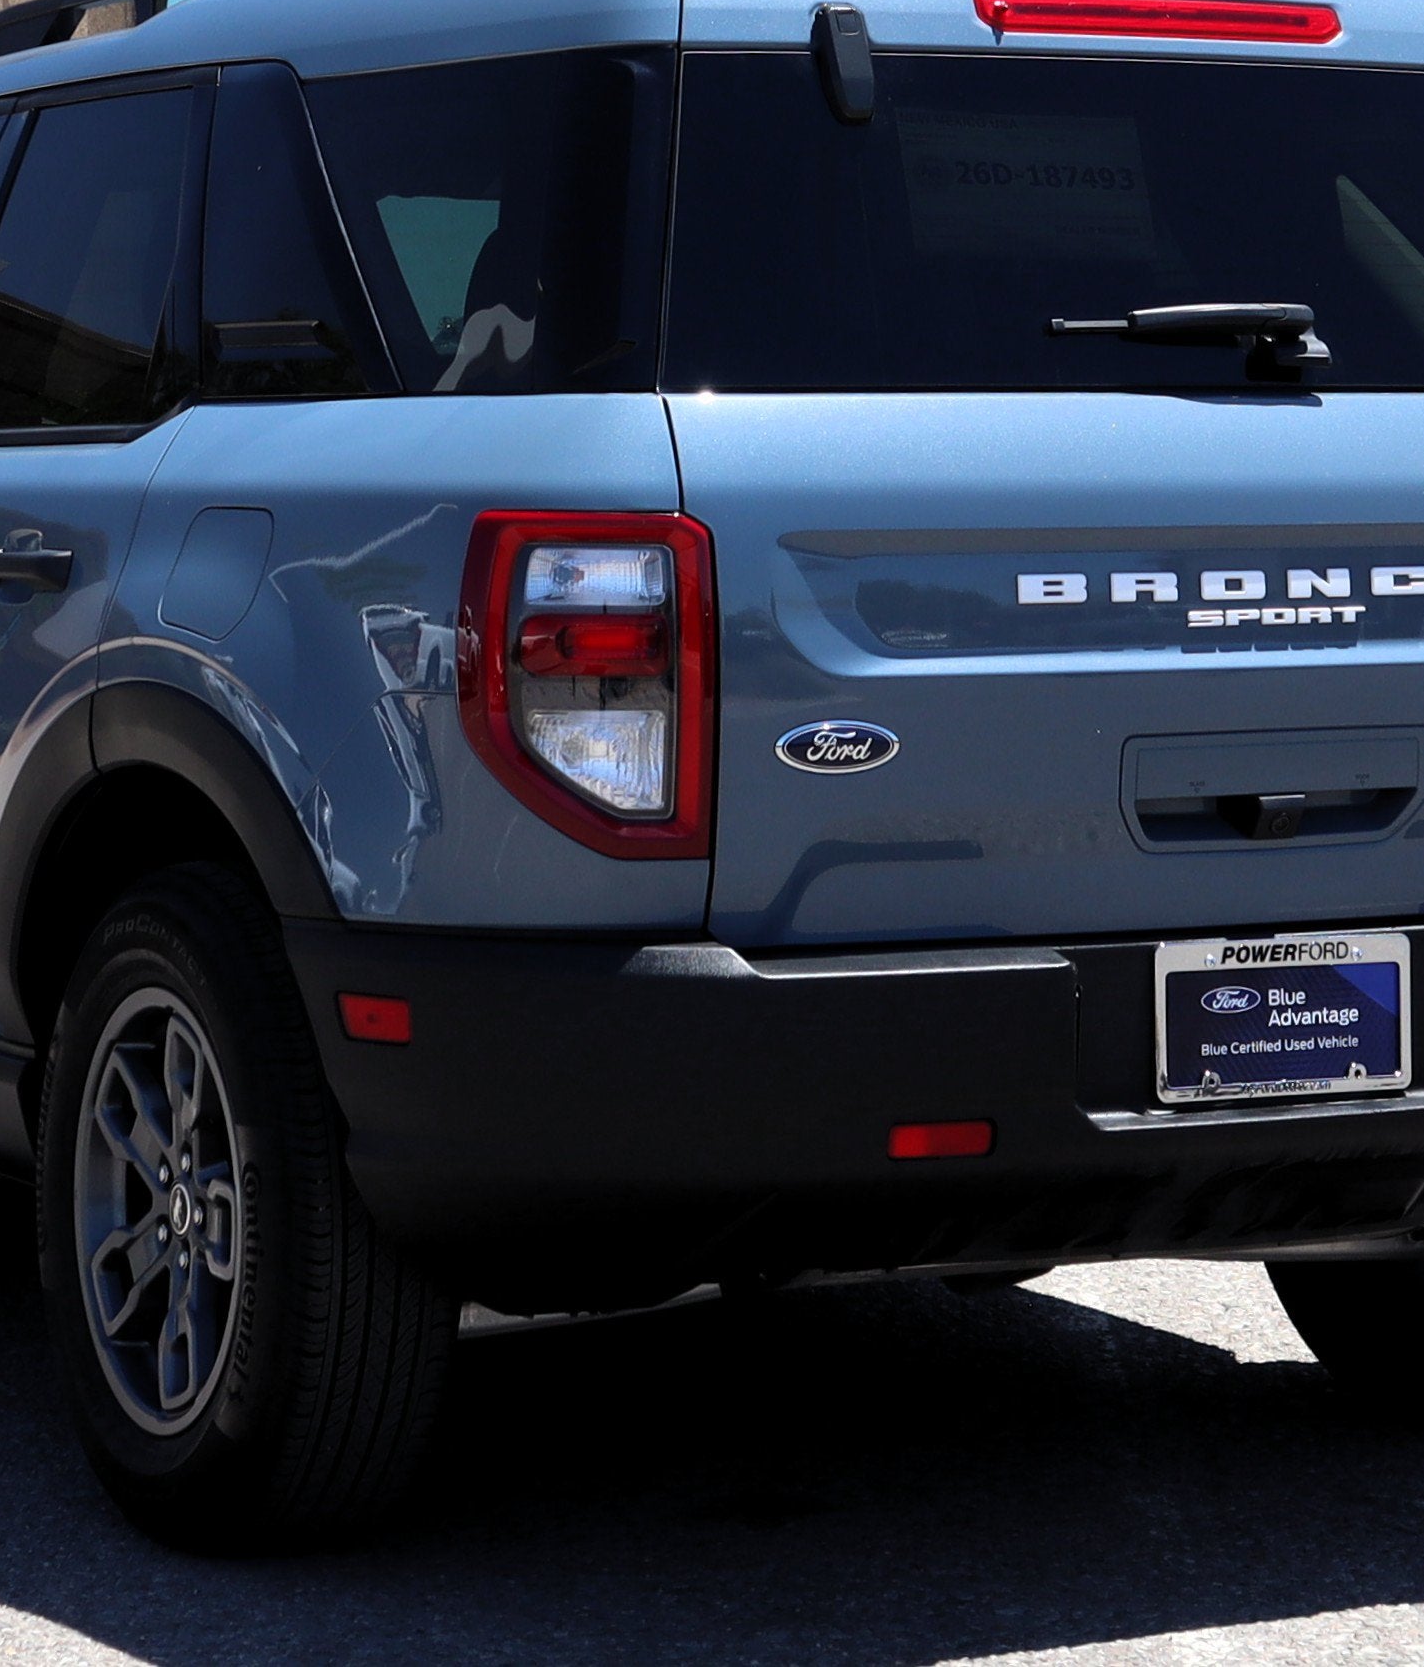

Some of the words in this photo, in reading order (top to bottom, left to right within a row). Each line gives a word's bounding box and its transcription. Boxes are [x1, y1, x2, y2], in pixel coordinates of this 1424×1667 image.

[955, 160, 1135, 191] 26D-187493
[1186, 604, 1366, 629] SPORT
[806, 730, 873, 761] Ford
[1221, 941, 1349, 964] POWERFORD
[1212, 990, 1249, 1010] Ford
[1268, 988, 1306, 1006] Blue
[1268, 1007, 1359, 1027] Advantage
[1201, 1043, 1228, 1056] Blue
[1230, 1039, 1281, 1055] Certified
[1284, 1037, 1315, 1052] Used
[1317, 1035, 1359, 1050] Vehicle
[231, 1162, 265, 1379] Continental
